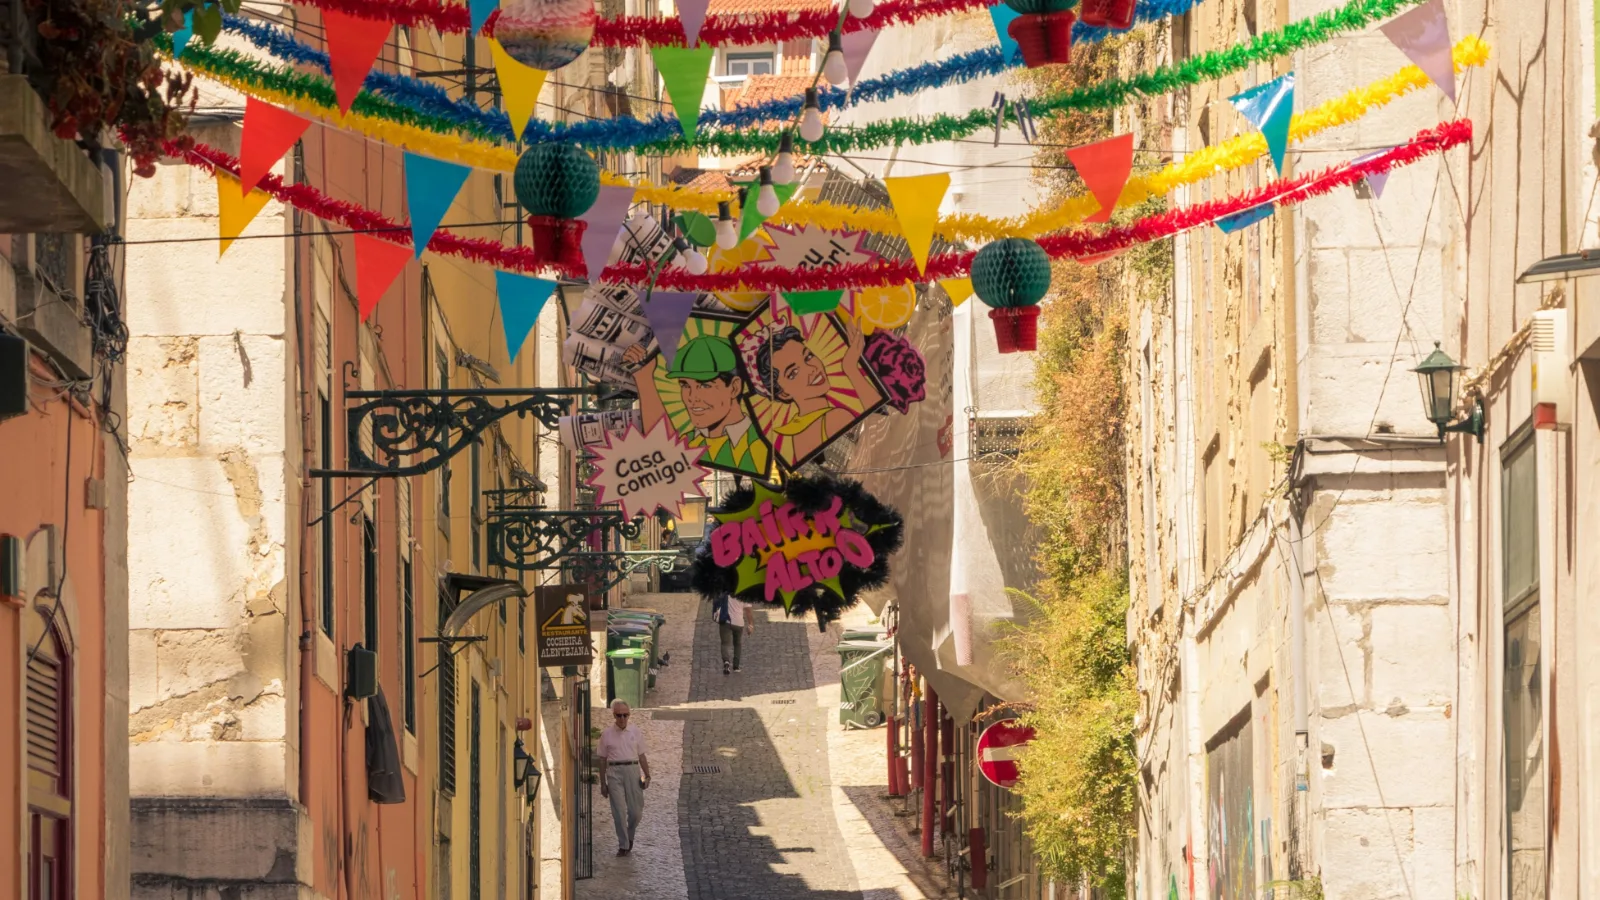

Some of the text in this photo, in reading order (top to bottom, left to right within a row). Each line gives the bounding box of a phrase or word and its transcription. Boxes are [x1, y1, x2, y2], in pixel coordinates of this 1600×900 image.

[798, 248, 824, 270] eu
[615, 450, 666, 478] Casa
[617, 452, 691, 496] comigo!
[764, 547, 843, 601] ALTO
[542, 628, 588, 636] RESTAURANTE
[546, 636, 583, 647] COCHEIRA
[541, 646, 589, 658] ALENTEJANA
